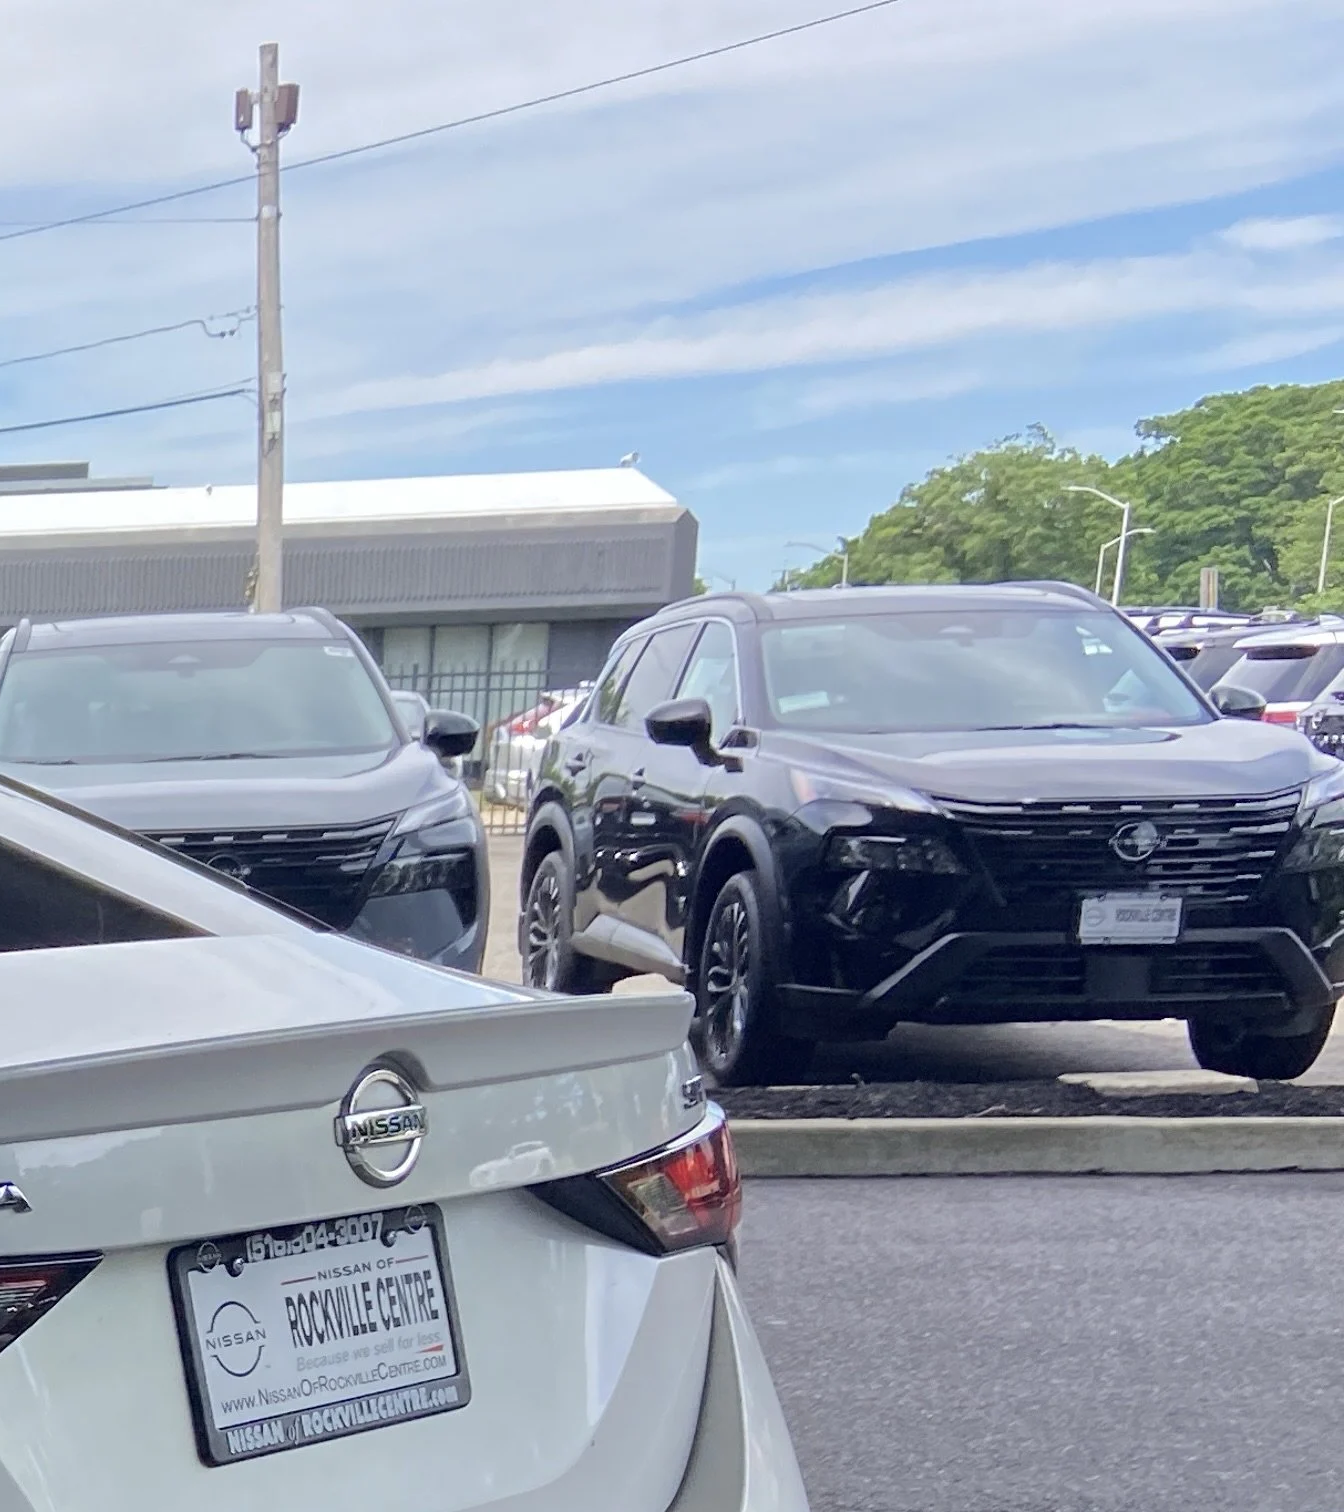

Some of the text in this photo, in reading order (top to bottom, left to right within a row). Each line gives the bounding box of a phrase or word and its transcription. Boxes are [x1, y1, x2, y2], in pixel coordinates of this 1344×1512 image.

[350, 1111, 425, 1138] NISSAN
[317, 1257, 396, 1281] NISSAN OF
[284, 1269, 439, 1349] ROCKVILLE CENTRE
[206, 1328, 267, 1350] NISSAN
[296, 1350, 350, 1372] Because
[353, 1346, 371, 1361] we
[373, 1338, 395, 1356] sell
[226, 1420, 285, 1454] NISSAN
[287, 1416, 301, 1446] of
